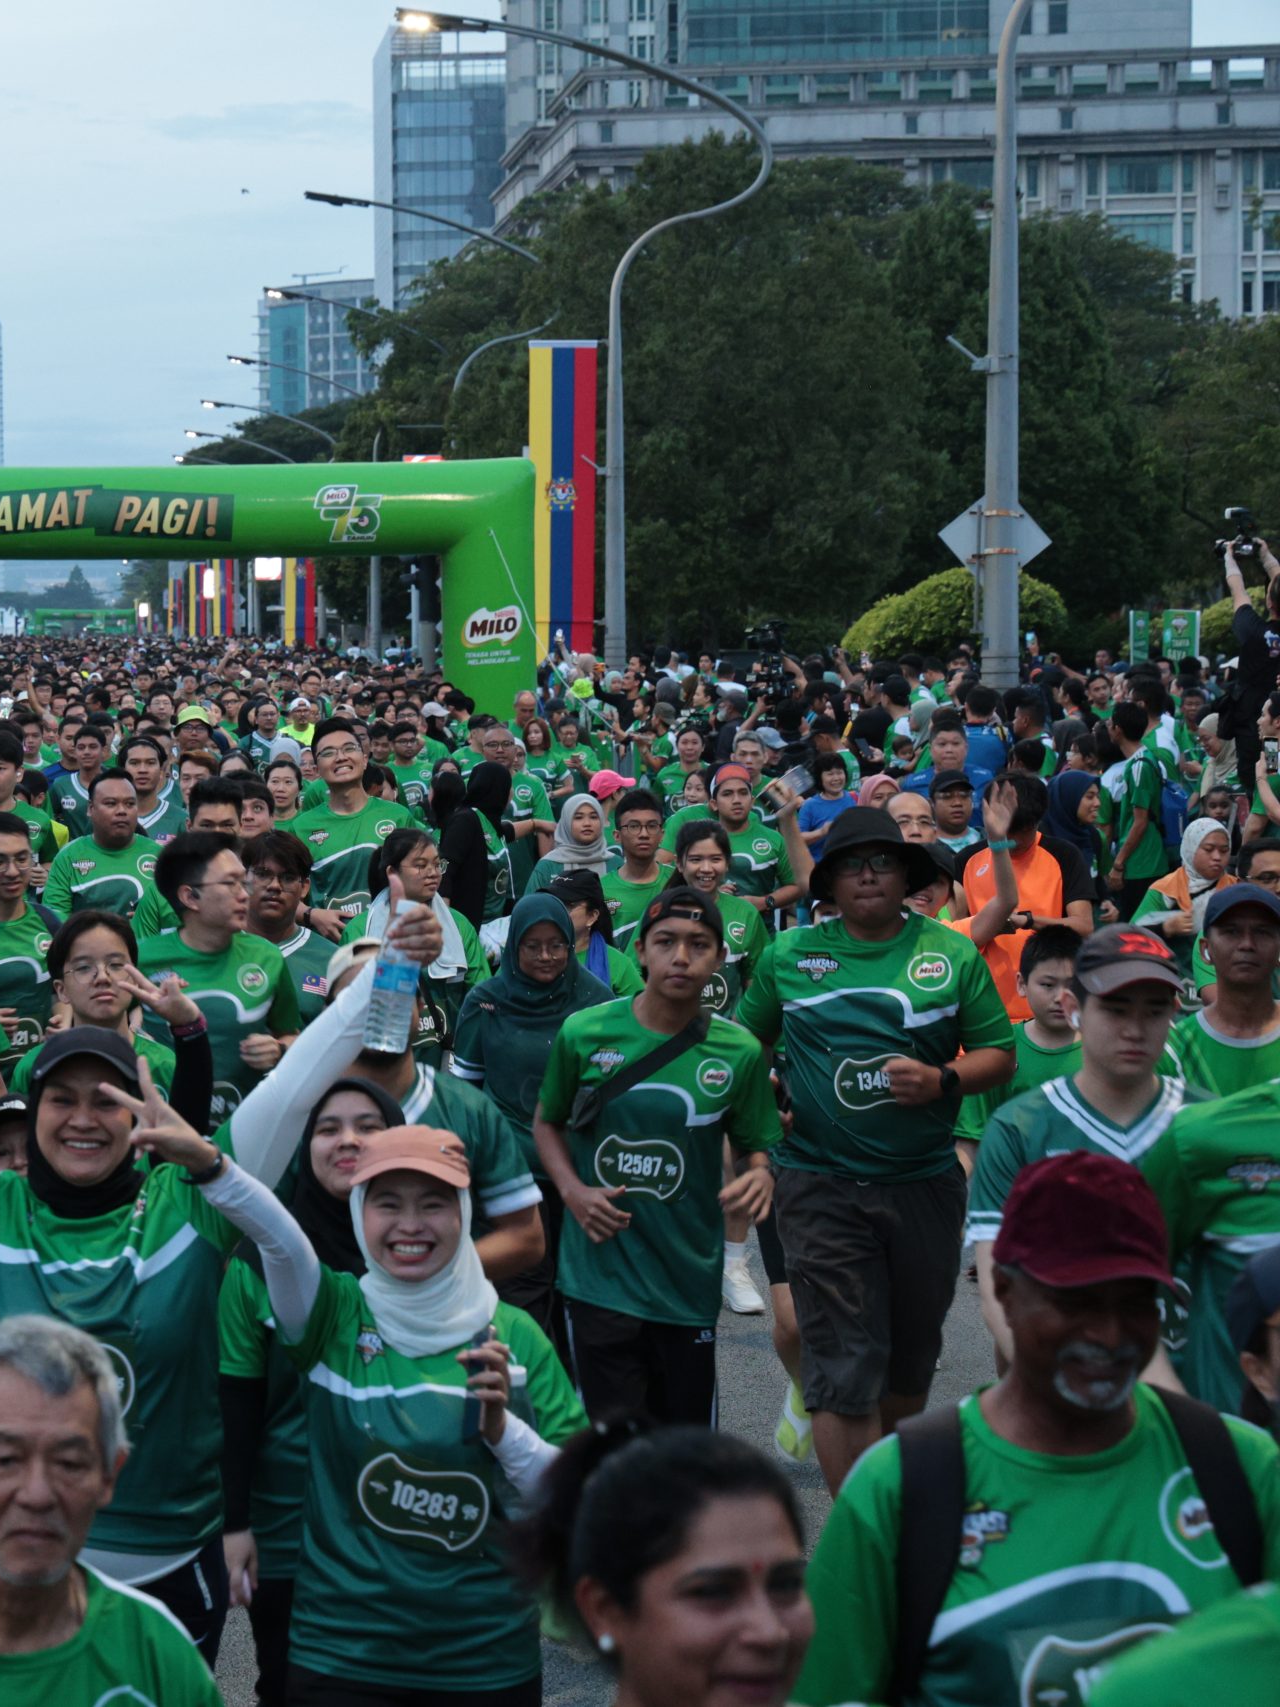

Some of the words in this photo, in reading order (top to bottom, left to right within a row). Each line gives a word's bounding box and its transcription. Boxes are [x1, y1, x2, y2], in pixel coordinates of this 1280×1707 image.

[327, 492, 347, 500] MILO
[114, 496, 219, 538] PAGI!
[469, 617, 517, 638] MILO
[340, 903, 363, 916] 11917
[797, 959, 839, 971] BREAKFAST
[920, 966, 944, 977] MILO
[617, 1153, 663, 1178] 12587
[391, 1480, 458, 1521] 10283
